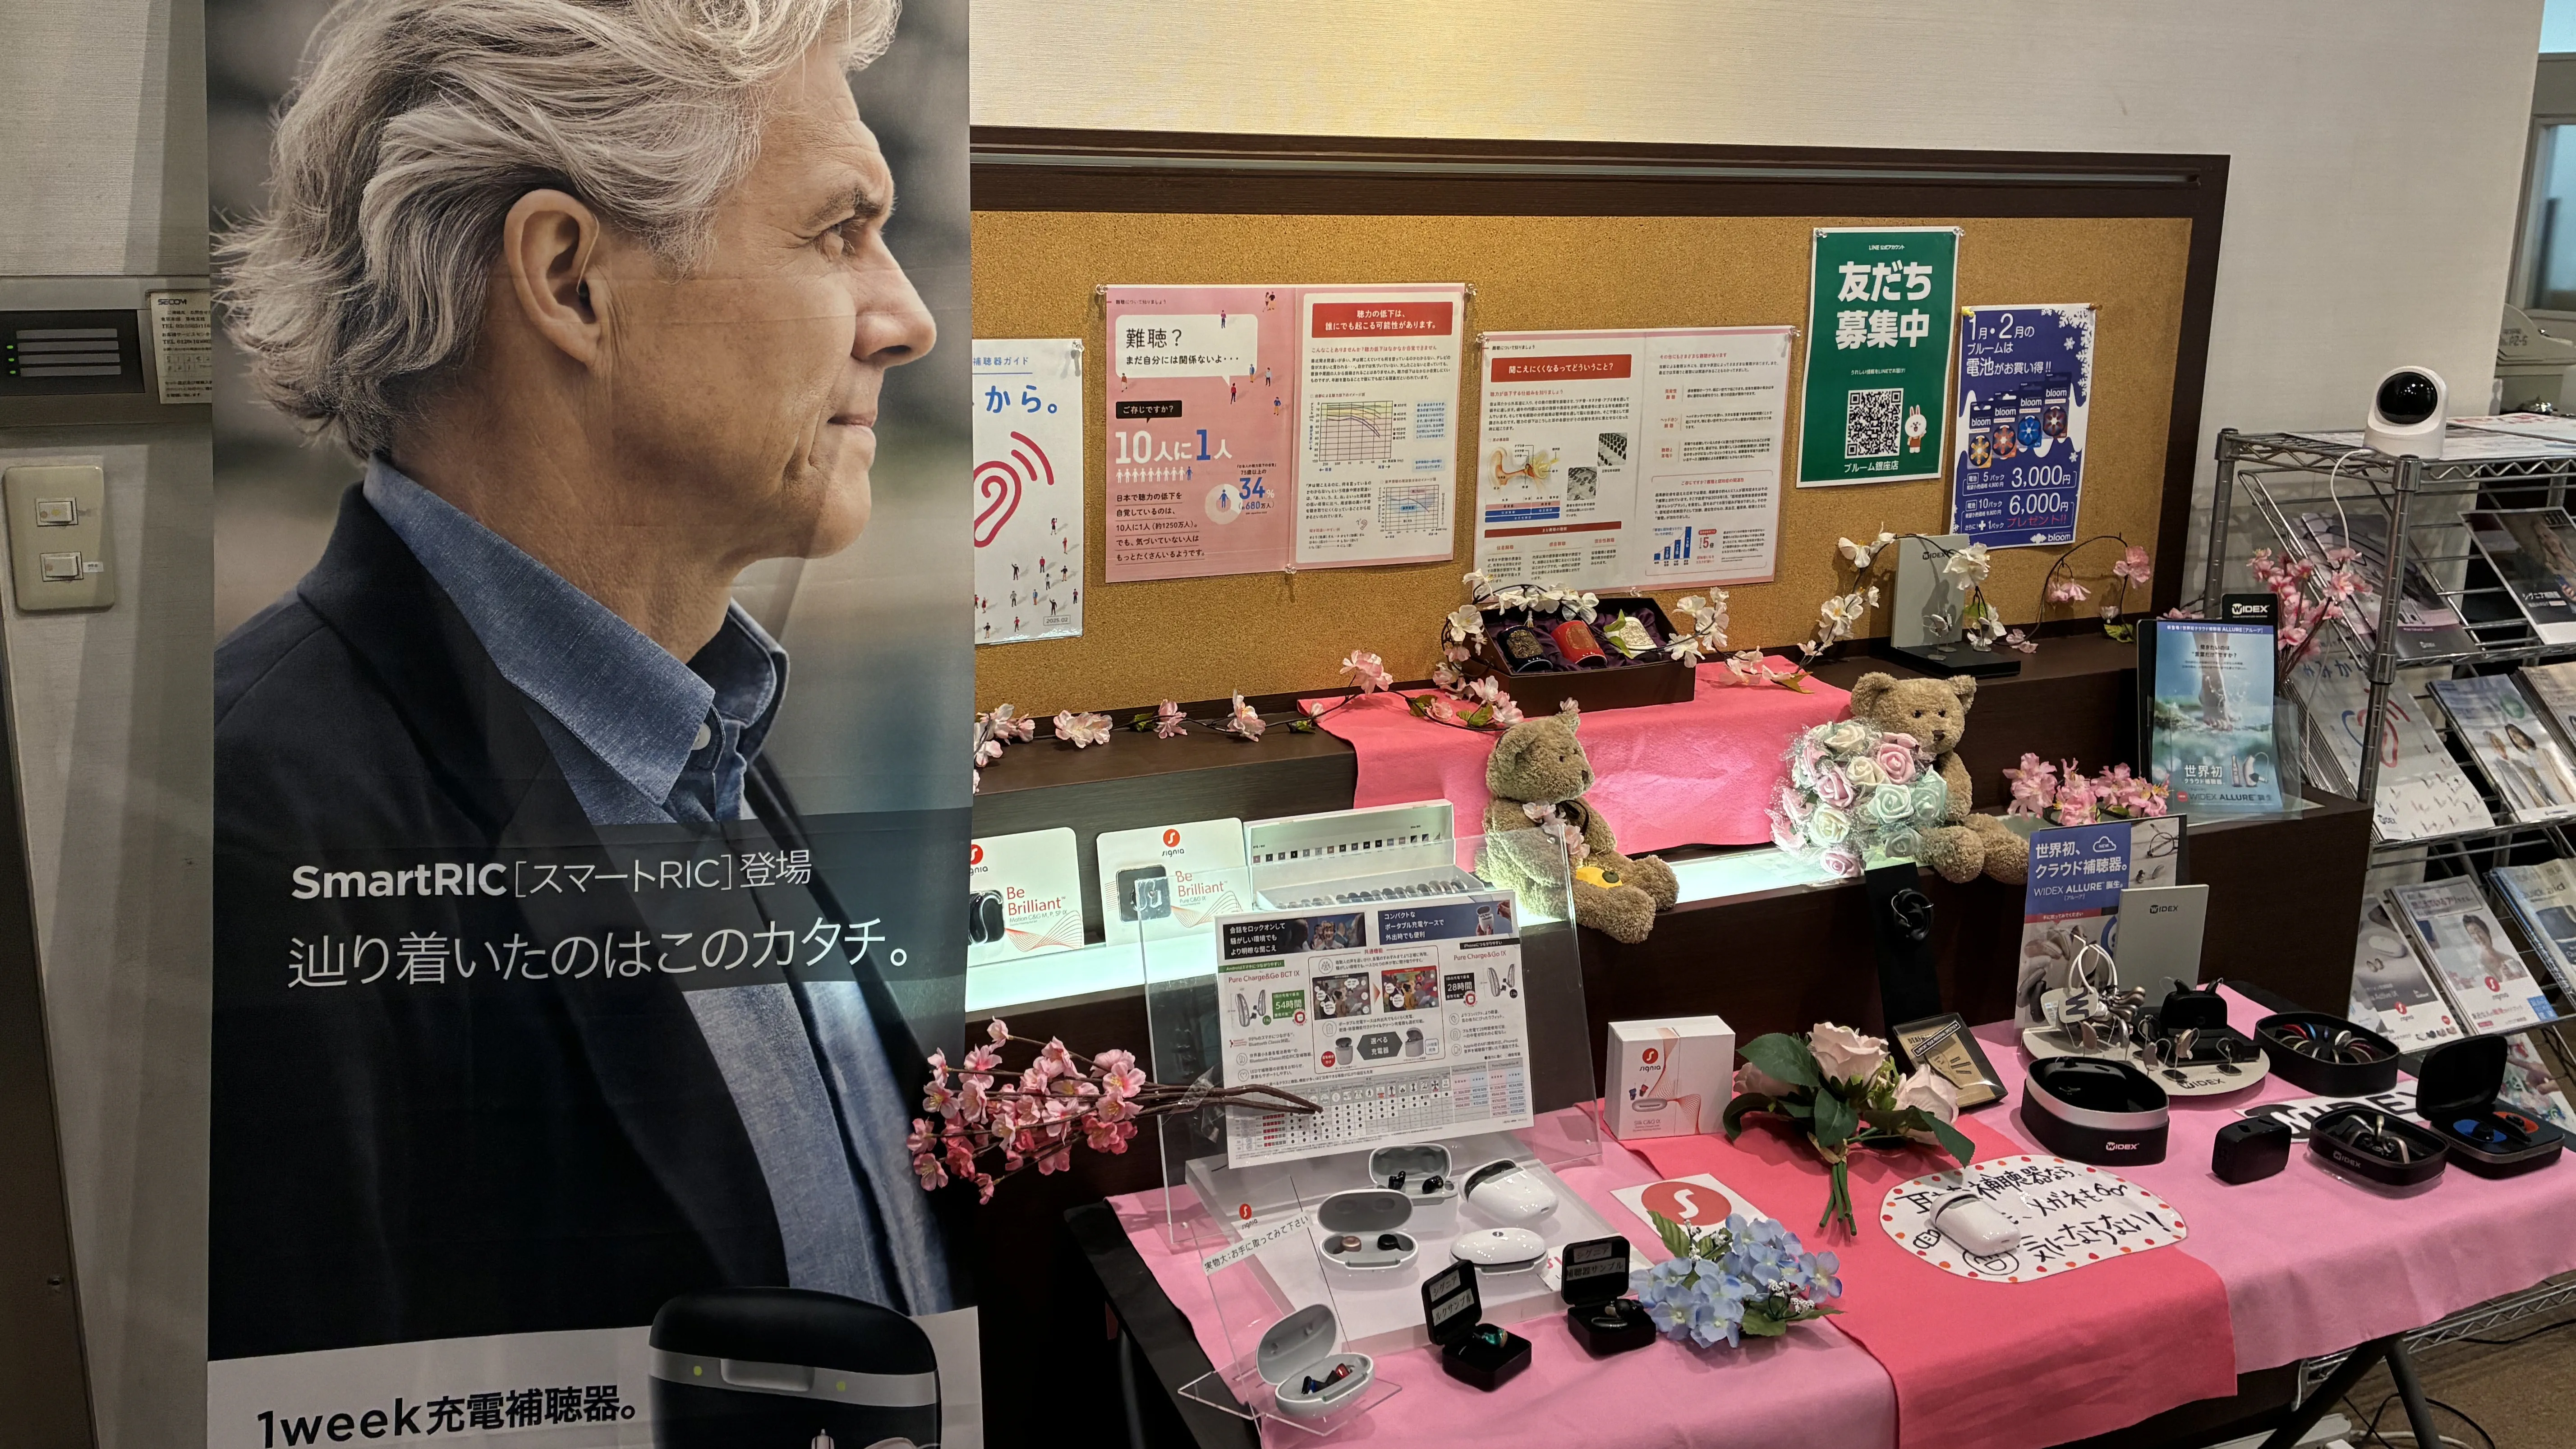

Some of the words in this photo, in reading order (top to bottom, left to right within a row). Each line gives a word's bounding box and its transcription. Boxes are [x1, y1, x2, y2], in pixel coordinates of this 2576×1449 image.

[1837, 260, 1932, 302] 友だち
[1356, 309, 1406, 318] 聴力の低下は、
[1325, 320, 1436, 331] 誰にでも起こる可能性があります。
[1835, 308, 1930, 350] 募集中
[1126, 328, 1182, 349] 難聴？
[1967, 342, 2014, 355] ブルームは
[973, 357, 1029, 366] 補聴器ガイド
[2046, 389, 2067, 397] bloom
[984, 385, 1058, 414] から。
[2020, 398, 2042, 406] bloom
[1123, 405, 1174, 414] ご存じですか？
[1994, 408, 2016, 416] bloom
[1971, 418, 1991, 427] bloom
[1115, 429, 1233, 464] 10人に1人
[1844, 460, 1899, 473] ブルーム銀座店
[2011, 465, 2071, 488] 3,000円
[1239, 477, 1275, 500] 34%
[1116, 492, 1182, 502] 日本で聴力の低下を
[2009, 492, 2069, 515] 6,000円
[1116, 507, 1176, 517] 自覚しているのは、
[1116, 535, 1199, 547] でも、気づいていない人は
[2048, 533, 2071, 542] bloom
[1116, 549, 1205, 561] もっとたくさんいるようです。
[1922, 549, 1947, 561] WIDEX
[2232, 603, 2269, 613] WIDEX
[1046, 617, 1068, 625] 2025.02
[2184, 764, 2223, 777] 世界初
[1162, 848, 1185, 857] signia
[2035, 841, 2080, 859] 世界初、
[970, 865, 989, 876] gnia
[2035, 856, 2127, 879] クラウド補聴器。
[1175, 870, 1193, 883] Be
[1007, 886, 1025, 900] Be
[2034, 886, 2064, 897] WIDEX
[2149, 904, 2178, 914] WIDEX
[1384, 911, 1416, 920] コンパクトな
[1230, 923, 1286, 934] 会話をロックオンして
[1385, 920, 1444, 930] ポータブル充電ケースで
[1230, 934, 1277, 945] 騒がしい環境でも
[1385, 931, 1426, 941] 外出時でも便利
[287, 915, 908, 990] 辿り着いたのはこのカタチ。
[1243, 973, 1279, 982] Charge&Go
[1447, 981, 1472, 992] 28時間
[1275, 999, 1302, 1010] 54時間
[2177, 1077, 2226, 1089] WIDEX
[2106, 1142, 2139, 1151] WIDEX
[1241, 1219, 1258, 1229] signia
[257, 1385, 636, 1449] 1week充電補聴器。
